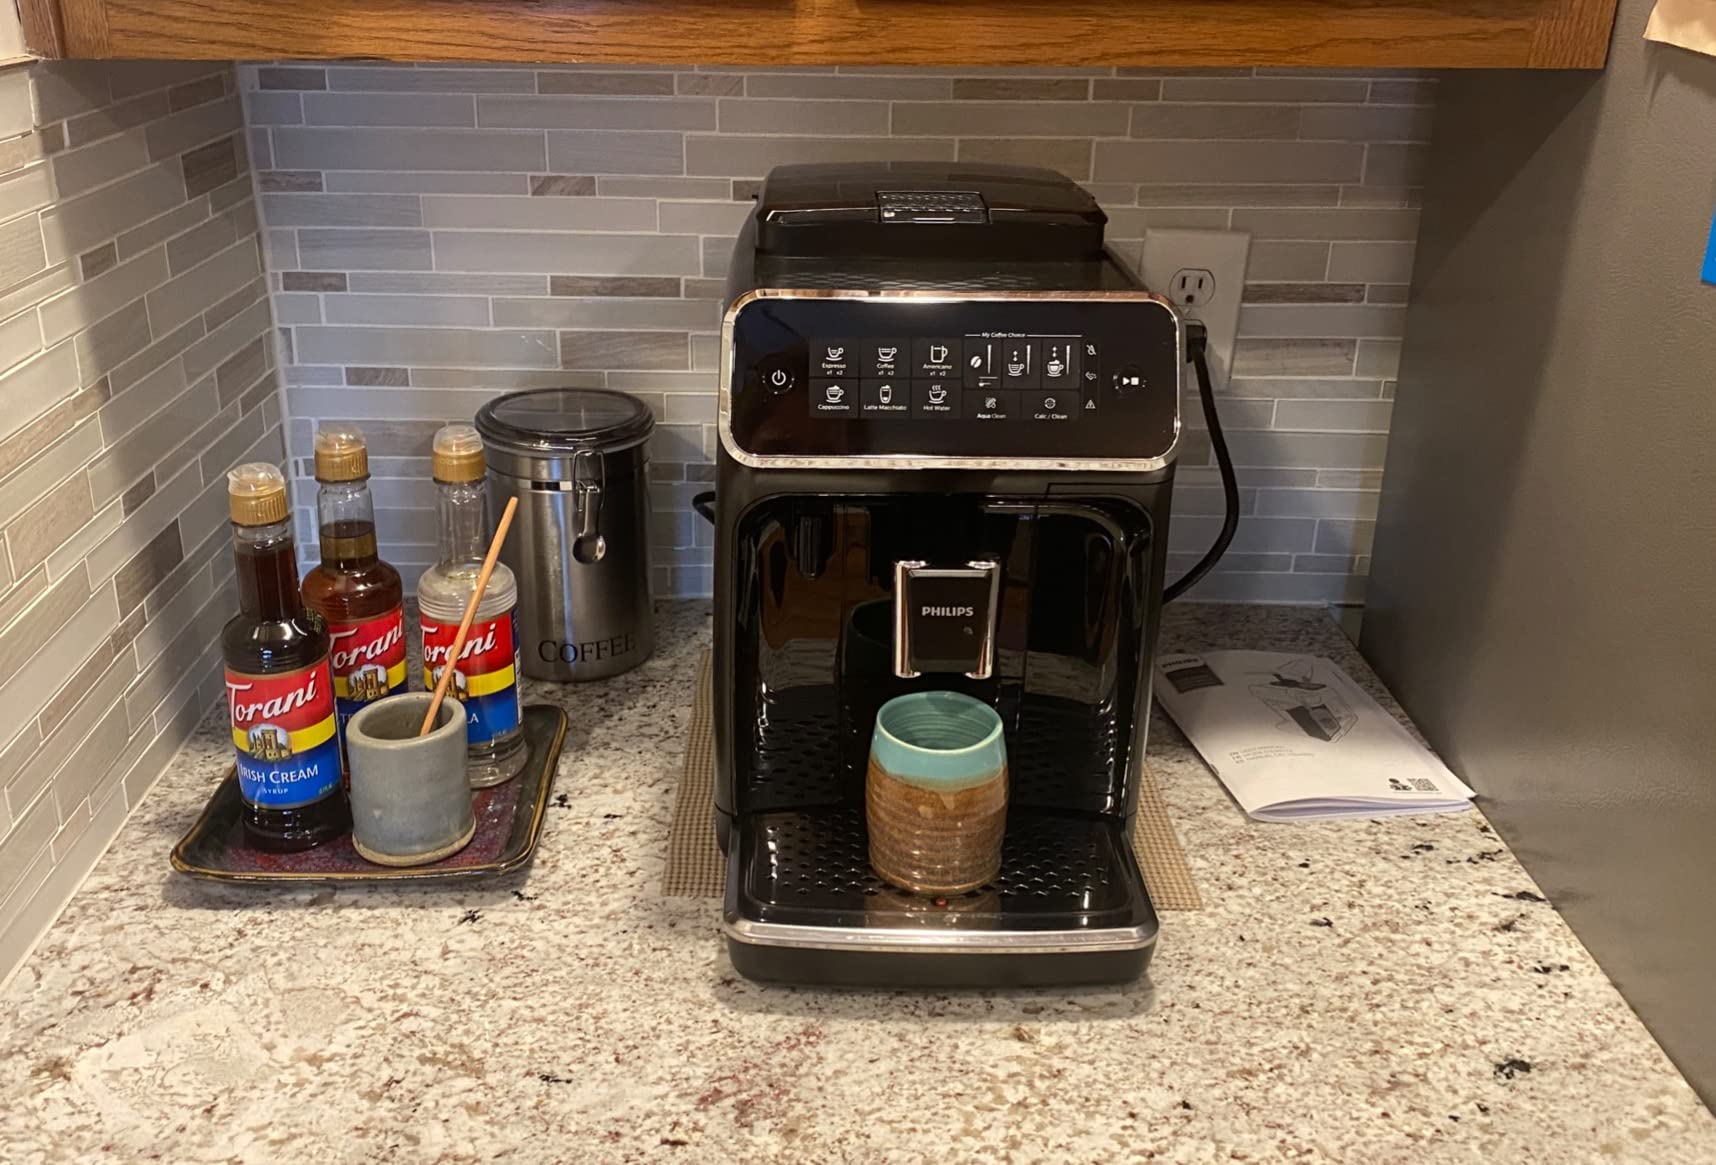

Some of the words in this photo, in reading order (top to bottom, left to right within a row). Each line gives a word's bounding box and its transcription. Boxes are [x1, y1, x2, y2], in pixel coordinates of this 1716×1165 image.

[921, 606, 974, 617] PHILIPS
[329, 608, 403, 669] Torani
[538, 633, 636, 663] COFFEE
[226, 671, 317, 727] Torani
[240, 763, 265, 783] IRISH
[269, 764, 319, 784] CREAM
[263, 787, 289, 795] SYRUP
